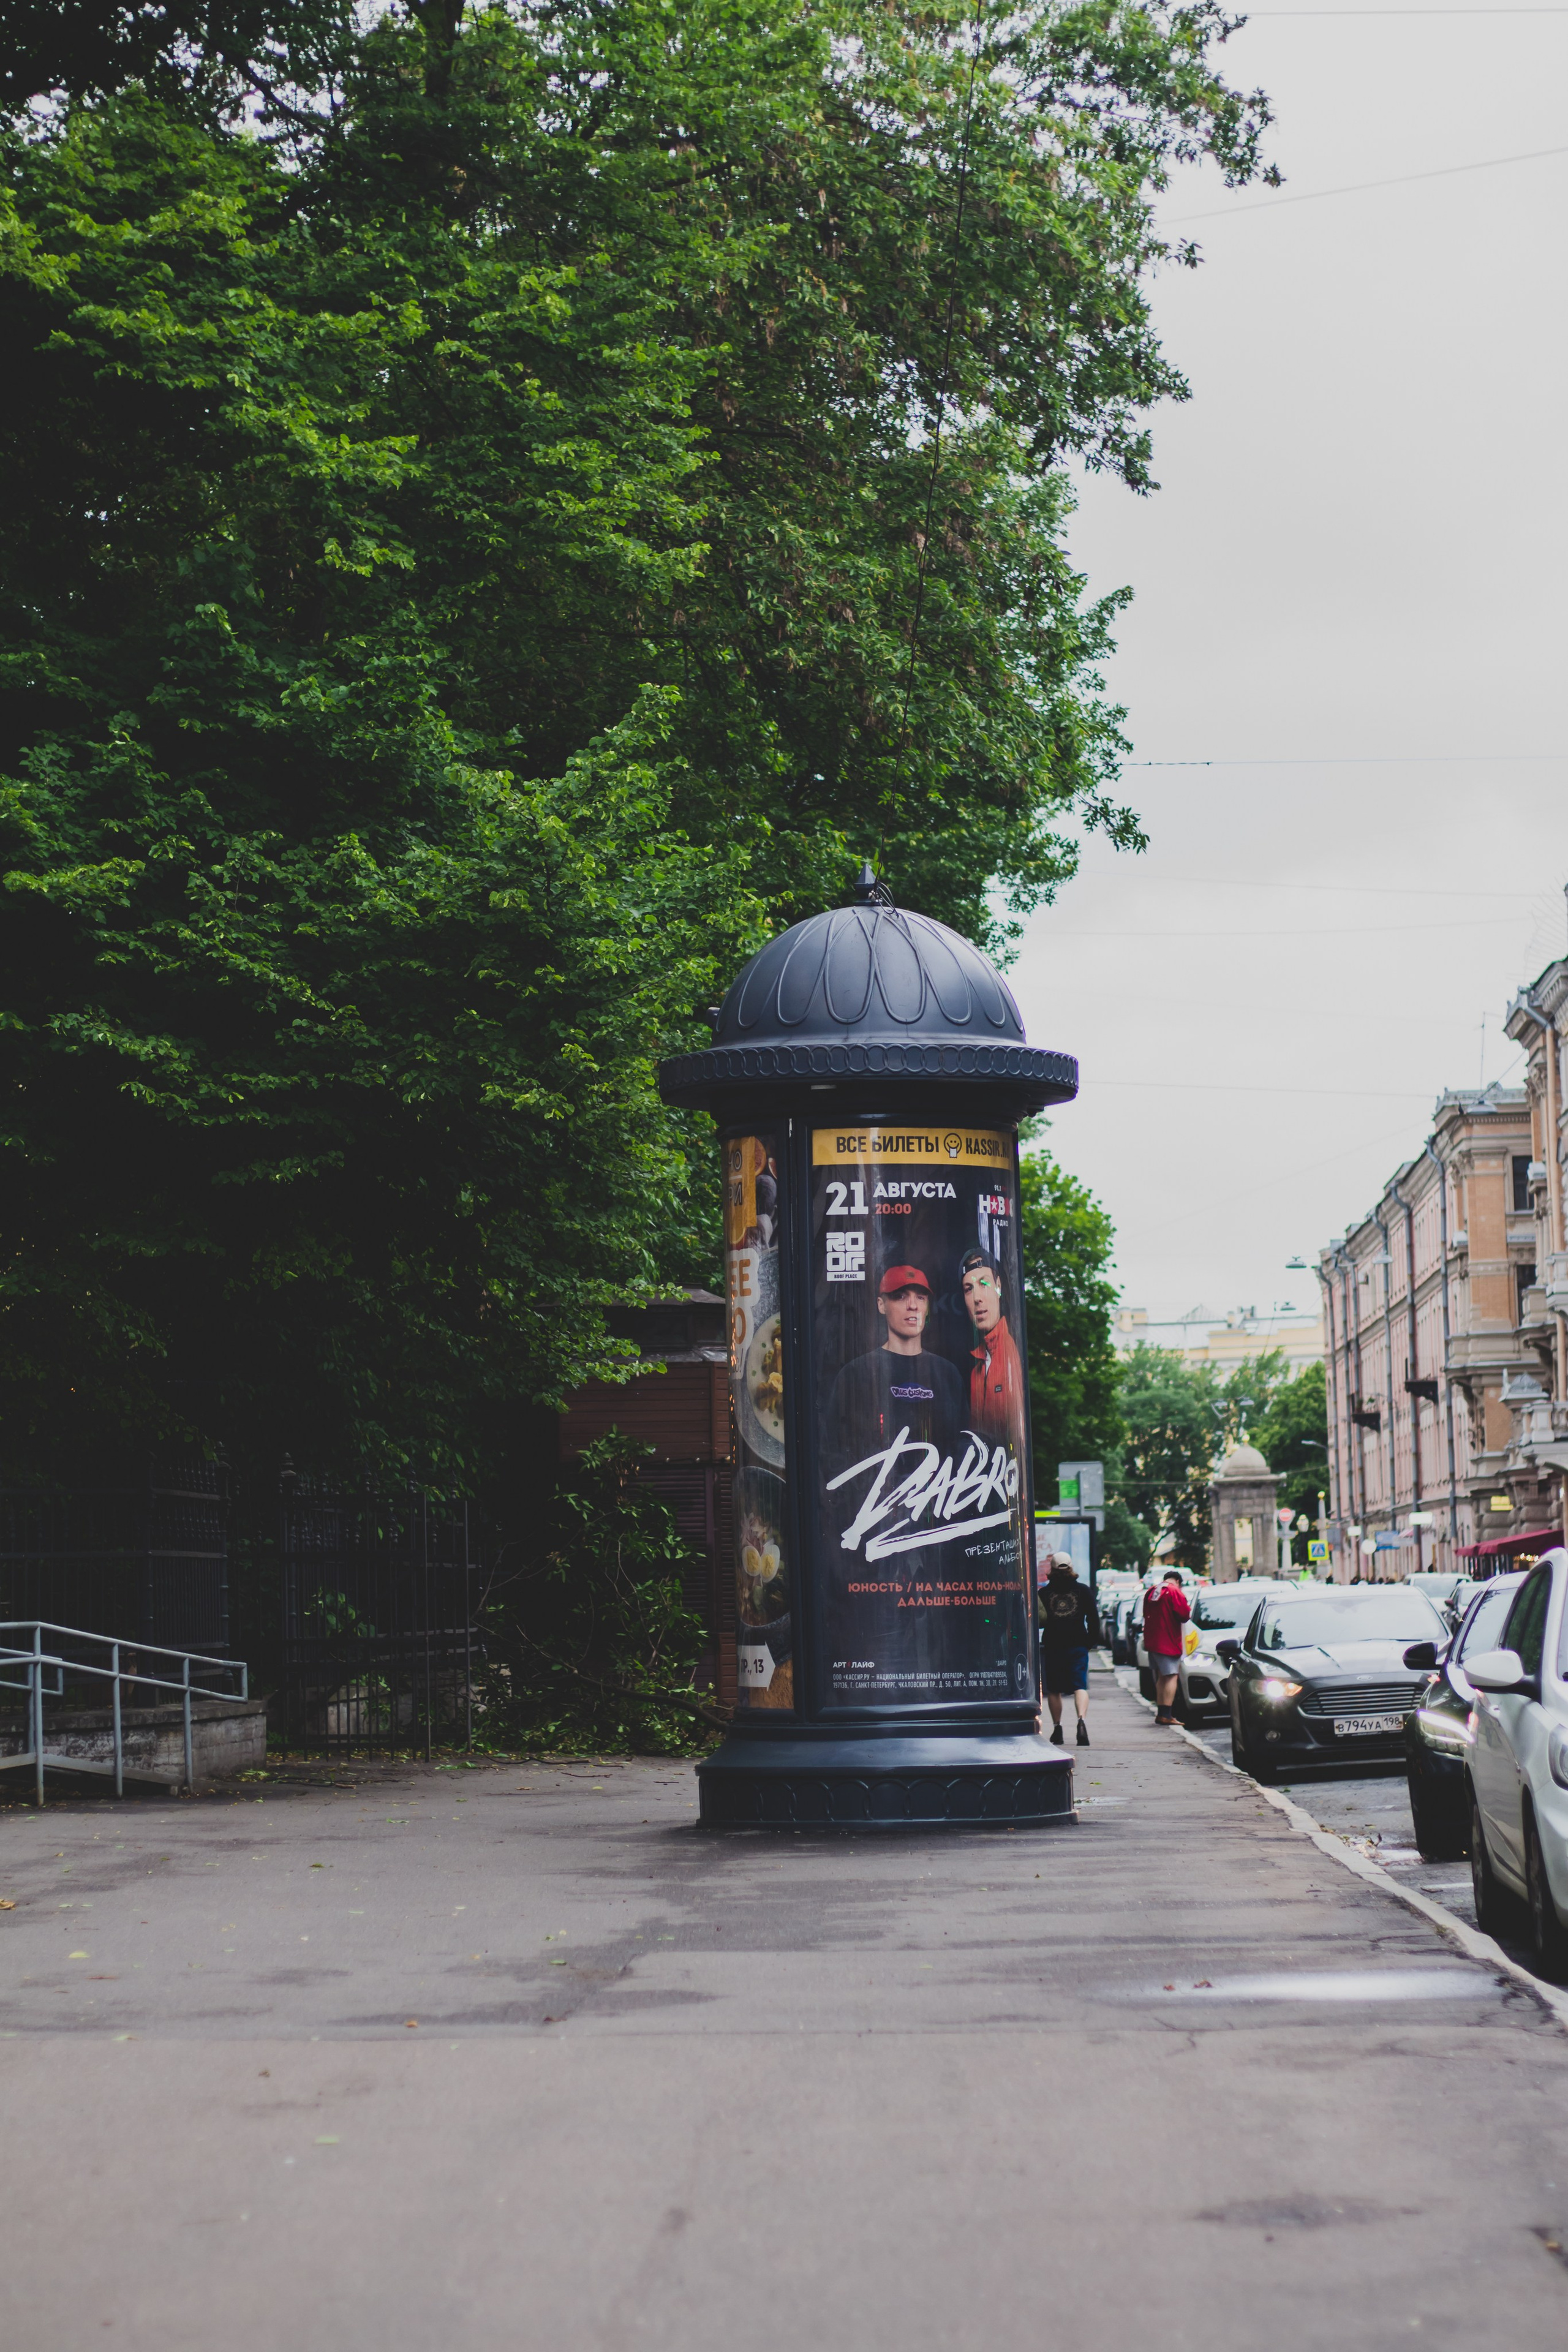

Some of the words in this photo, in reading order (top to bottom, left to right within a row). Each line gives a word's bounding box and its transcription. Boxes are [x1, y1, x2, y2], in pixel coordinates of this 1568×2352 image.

[836, 1136, 867, 1153] ВСЕ
[872, 1136, 939, 1153] БИЛЕТЫ
[966, 1137, 1010, 1159] KASSIR.RU
[826, 1182, 869, 1215] 21
[873, 1182, 957, 1199] АВГУСТА
[875, 1204, 911, 1215] 20:00
[993, 1218, 1009, 1227] РАДИО
[848, 1582, 903, 1593] ЮНОСТЬ
[916, 1582, 933, 1592] НА
[937, 1581, 973, 1591] ЧАСАХ
[897, 1596, 997, 1607] ДАЛЬШЕ-БОЛЬШЕ
[753, 1659, 764, 1673] 13
[876, 1672, 914, 1681] НАЦИОНАЛЬНЫЙ
[1384, 1717, 1400, 1726] 198
